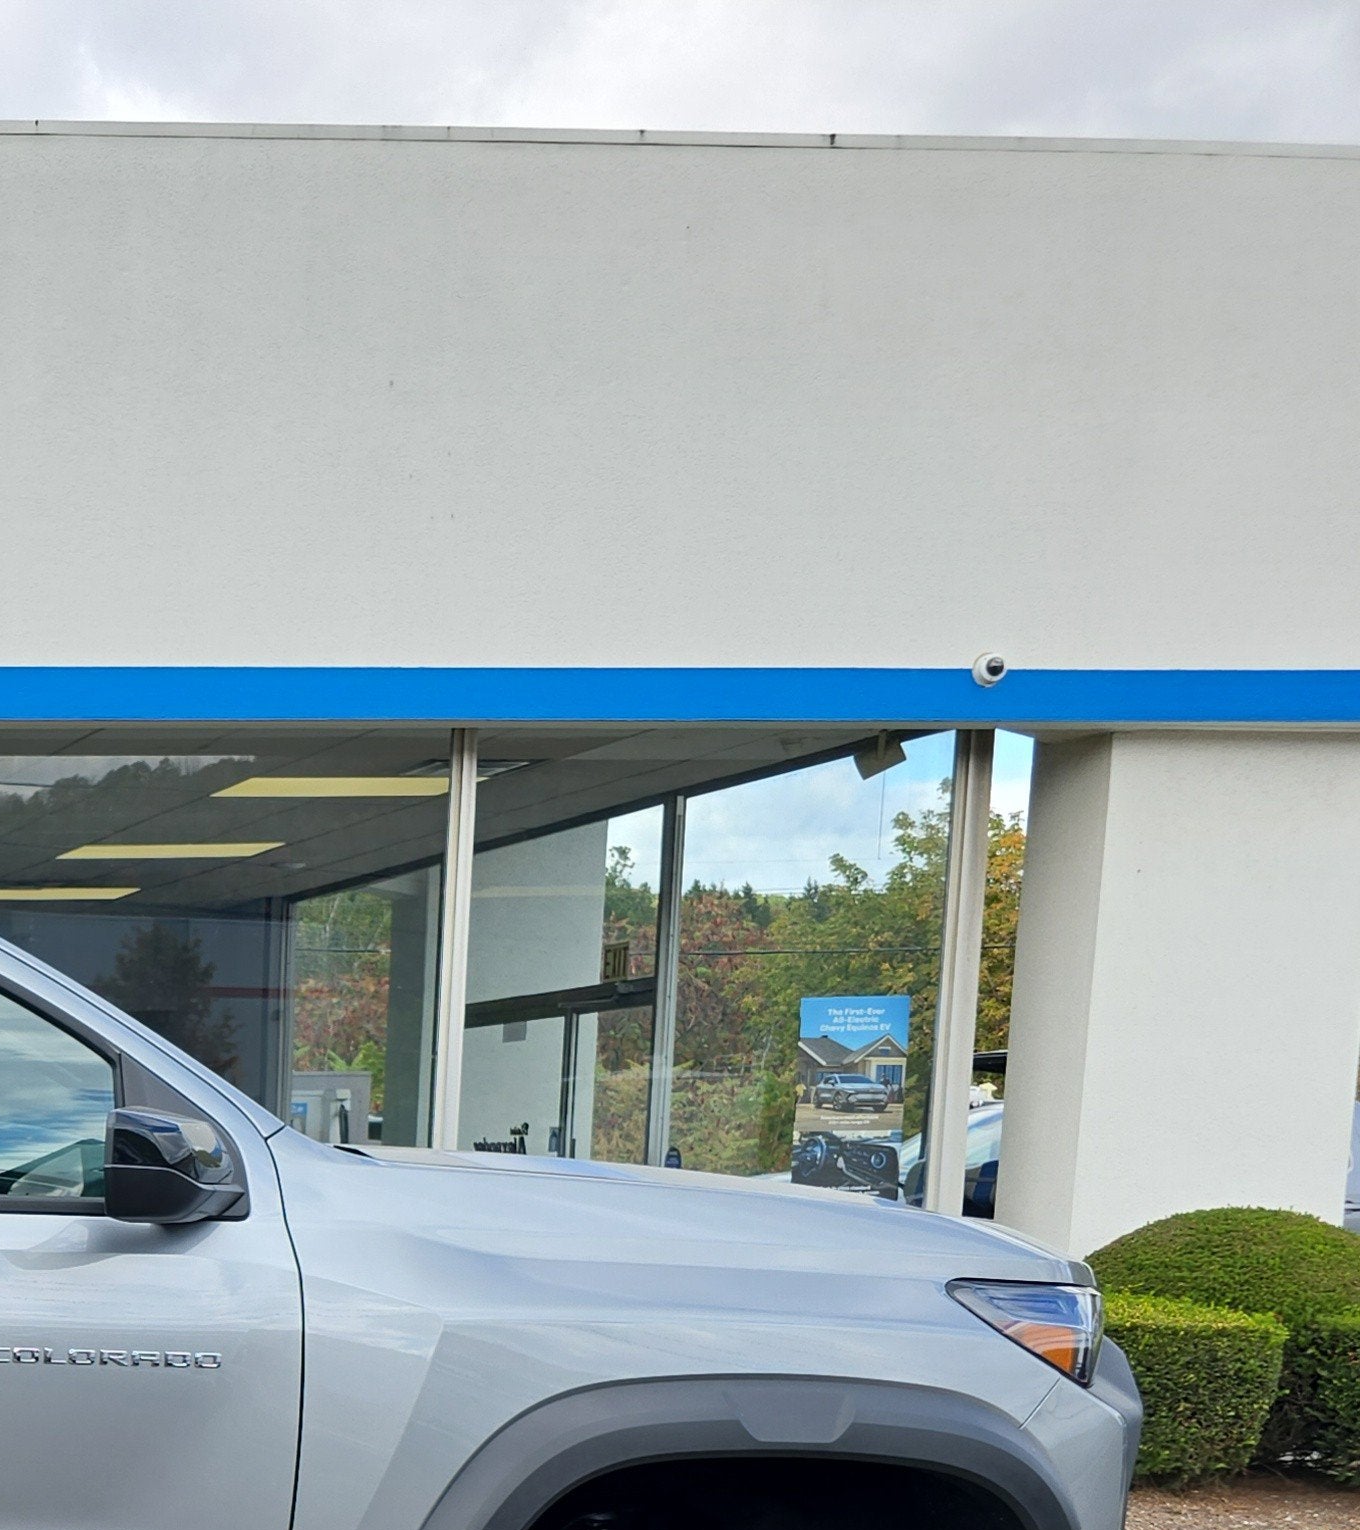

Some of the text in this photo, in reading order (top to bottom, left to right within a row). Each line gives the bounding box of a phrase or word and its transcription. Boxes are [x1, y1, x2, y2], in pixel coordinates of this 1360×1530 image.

[828, 1007, 885, 1016] The First-Ever
[820, 1024, 845, 1032] Chevy
[880, 1023, 891, 1031] EV
